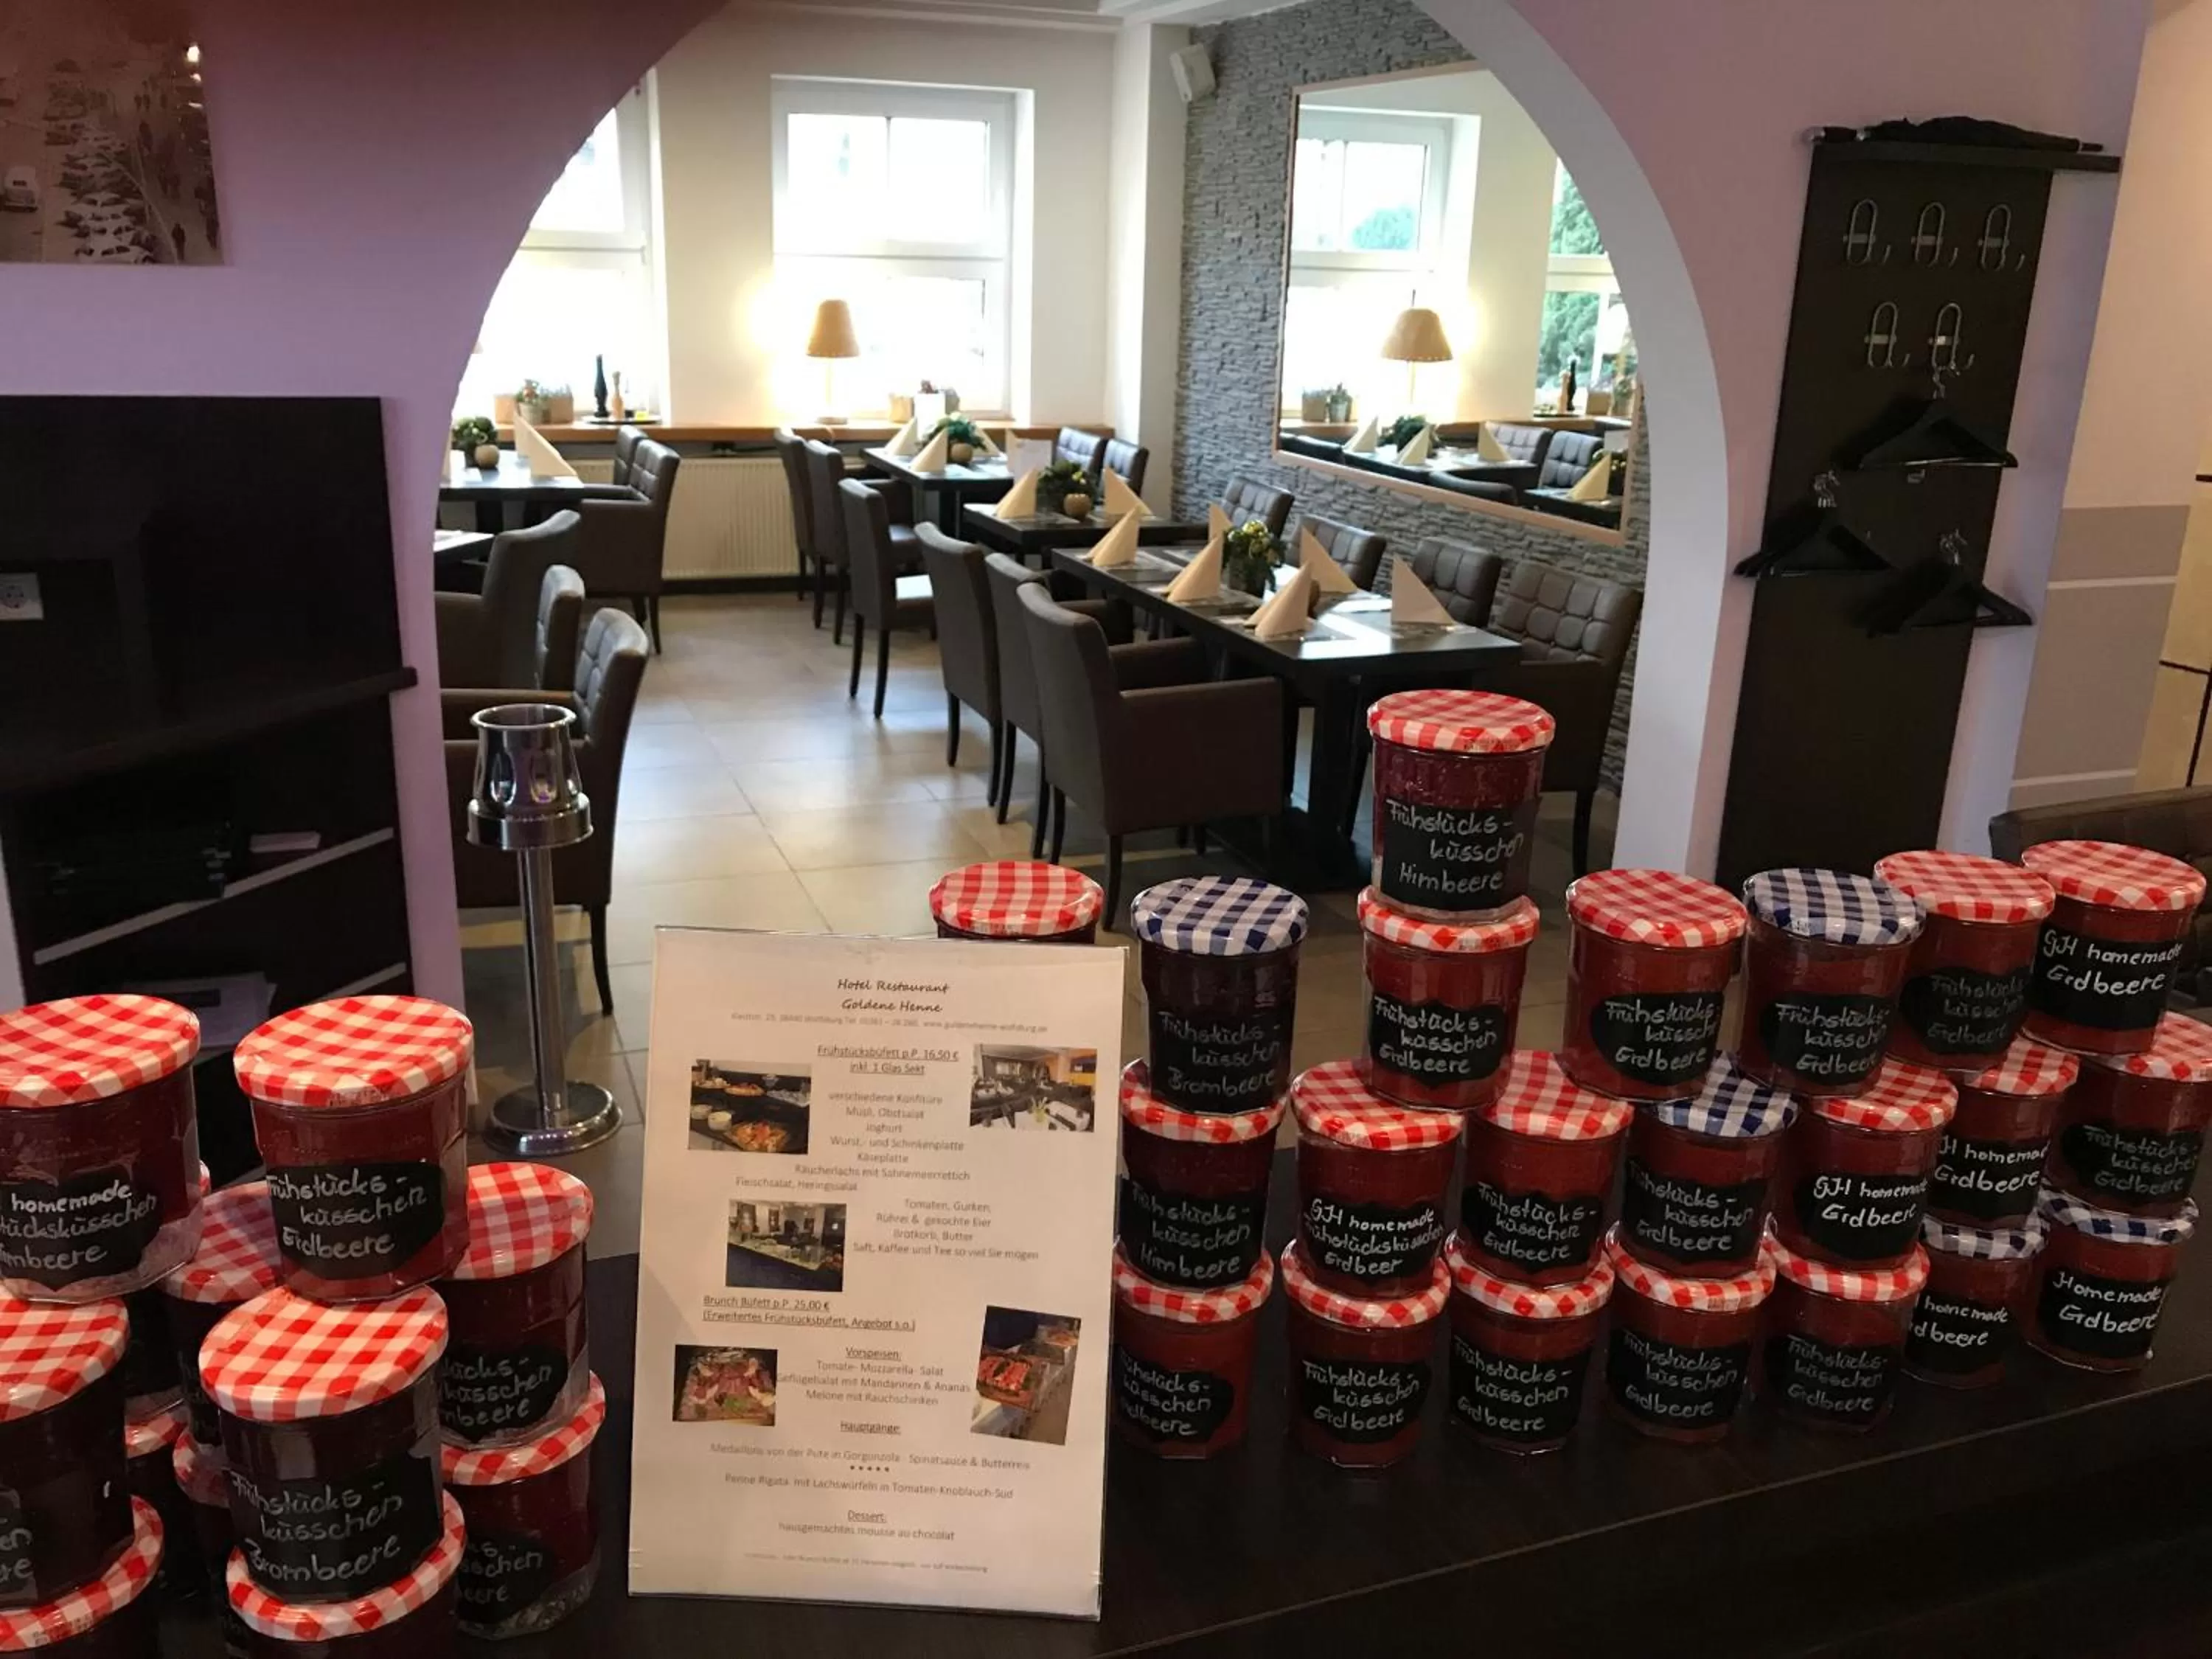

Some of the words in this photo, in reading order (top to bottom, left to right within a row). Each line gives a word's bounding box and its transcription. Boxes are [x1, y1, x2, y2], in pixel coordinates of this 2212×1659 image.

[1399, 861, 1503, 894] Himbeere
[838, 978, 872, 991] Hotel
[877, 980, 950, 994] Restaurant
[2046, 964, 2166, 995] Erdbeere
[841, 998, 896, 1011] Goldene
[900, 1001, 943, 1012] Henne
[1379, 1043, 1471, 1074] Erdbeere
[1615, 1045, 1707, 1071] Erdbeere
[869, 1138, 889, 1147] und
[862, 1167, 878, 1178] mit
[1934, 1163, 2041, 1194] Erdbeere
[11, 1179, 133, 1213] homemade
[973, 1217, 992, 1228] Eier
[1635, 1218, 1733, 1251] Erdbeere
[282, 1226, 395, 1259] Erdbeere
[942, 1231, 973, 1242] Butter
[1483, 1230, 1571, 1262] Erdbeere
[0, 1242, 108, 1270] imbeere
[878, 1243, 910, 1254] Kaffee
[912, 1244, 931, 1254] und
[934, 1245, 952, 1255] Tee
[955, 1248, 966, 1257] so
[968, 1248, 987, 1258] viel
[988, 1248, 1003, 1258] Sie
[1141, 1242, 1242, 1280] Himbeere
[703, 1295, 737, 1307] Brunch
[824, 1301, 830, 1311] €
[851, 1318, 893, 1331] Angebot
[2058, 1304, 2159, 1334] Erdbeere
[1909, 1321, 1989, 1348] dbeere
[920, 1365, 944, 1376] Salat
[806, 1390, 844, 1402] Melone
[846, 1392, 863, 1402] mit
[841, 1377, 858, 1386] mit
[934, 1381, 970, 1393] Ananas
[1624, 1383, 1714, 1418] Erdbeere
[1313, 1405, 1405, 1430] Erdbeere
[1457, 1395, 1546, 1432] Erdbeere
[767, 1447, 785, 1456] von
[787, 1447, 803, 1457] der
[832, 1450, 843, 1459] in
[726, 1472, 756, 1485] Penne
[793, 1476, 810, 1488] mit
[880, 1482, 890, 1491] in
[897, 1528, 911, 1539] au
[912, 1528, 955, 1541] chocolat
[244, 1534, 401, 1582] Brombeere
